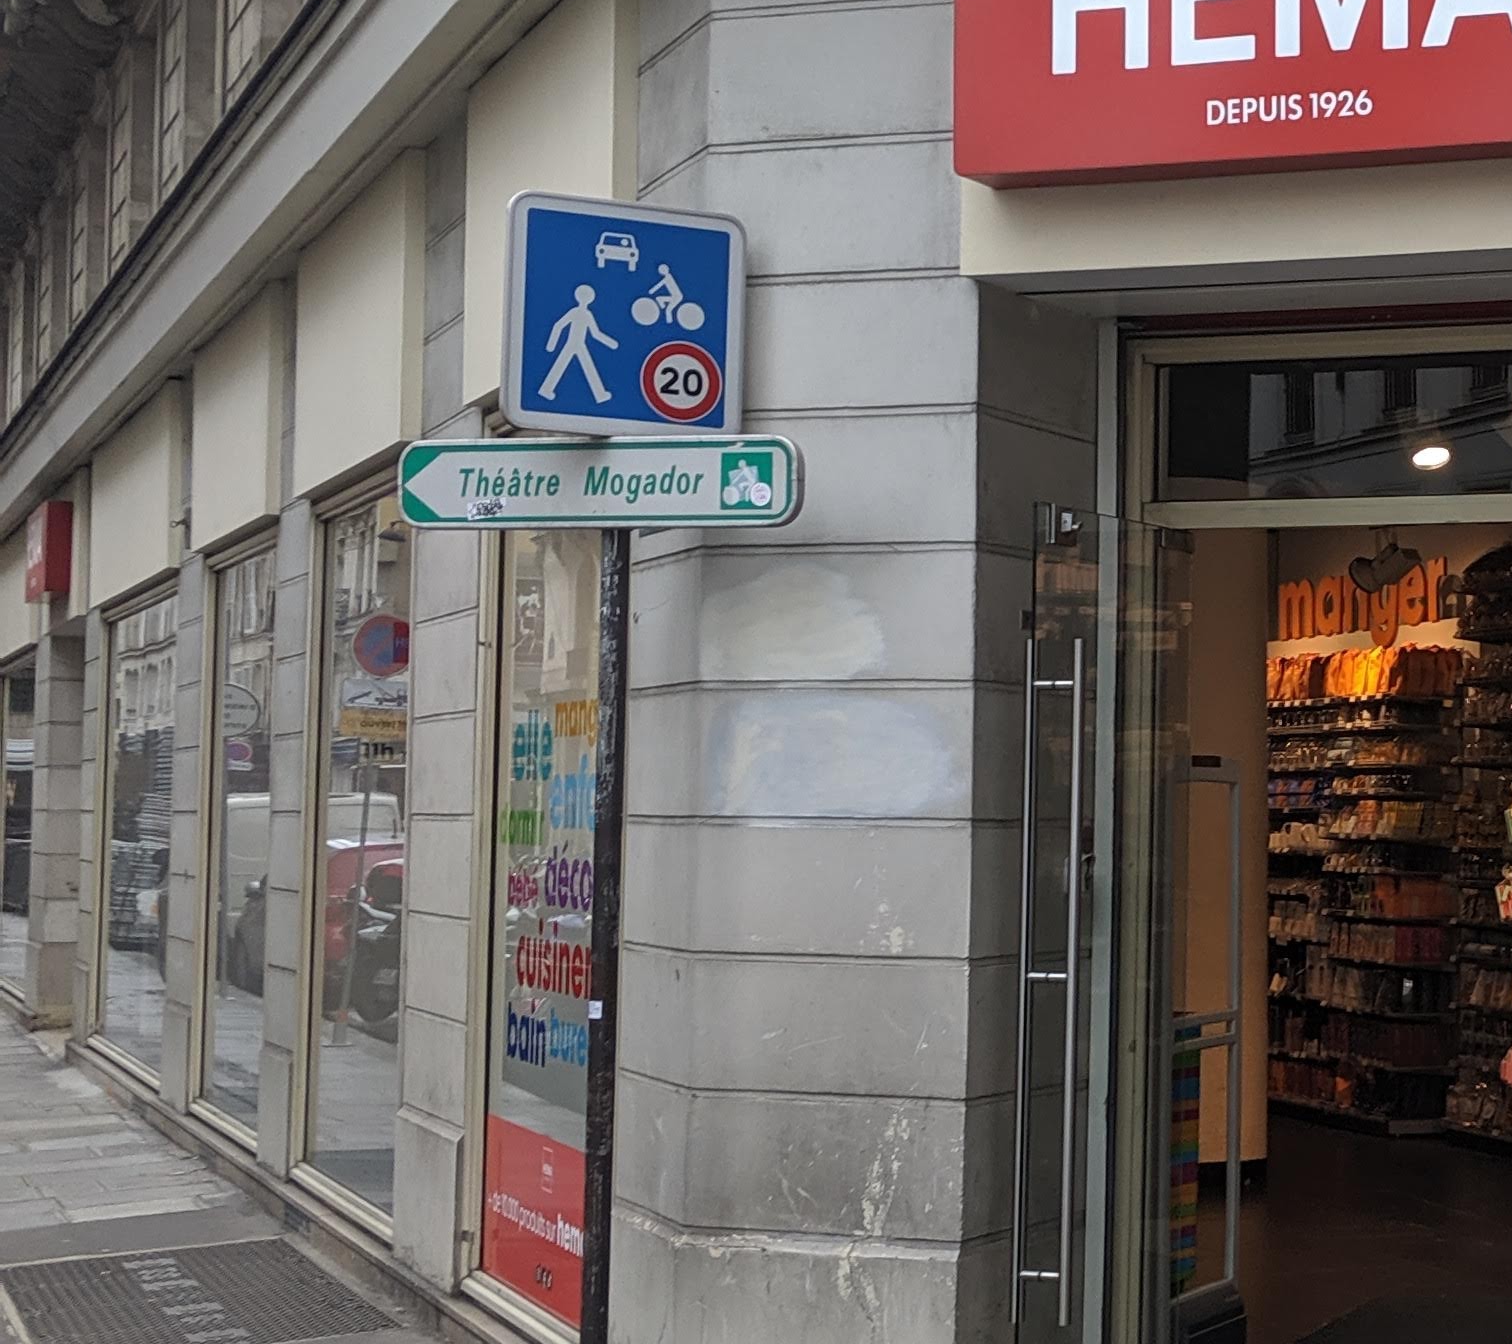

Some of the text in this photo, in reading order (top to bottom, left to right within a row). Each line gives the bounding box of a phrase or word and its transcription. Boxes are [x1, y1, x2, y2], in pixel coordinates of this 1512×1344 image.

[1206, 89, 1373, 127] DEPUIS 1926
[660, 366, 703, 398] 20
[459, 465, 704, 503] Théâtre Mogador
[1279, 556, 1447, 647] manger
[507, 998, 546, 1068] bain
